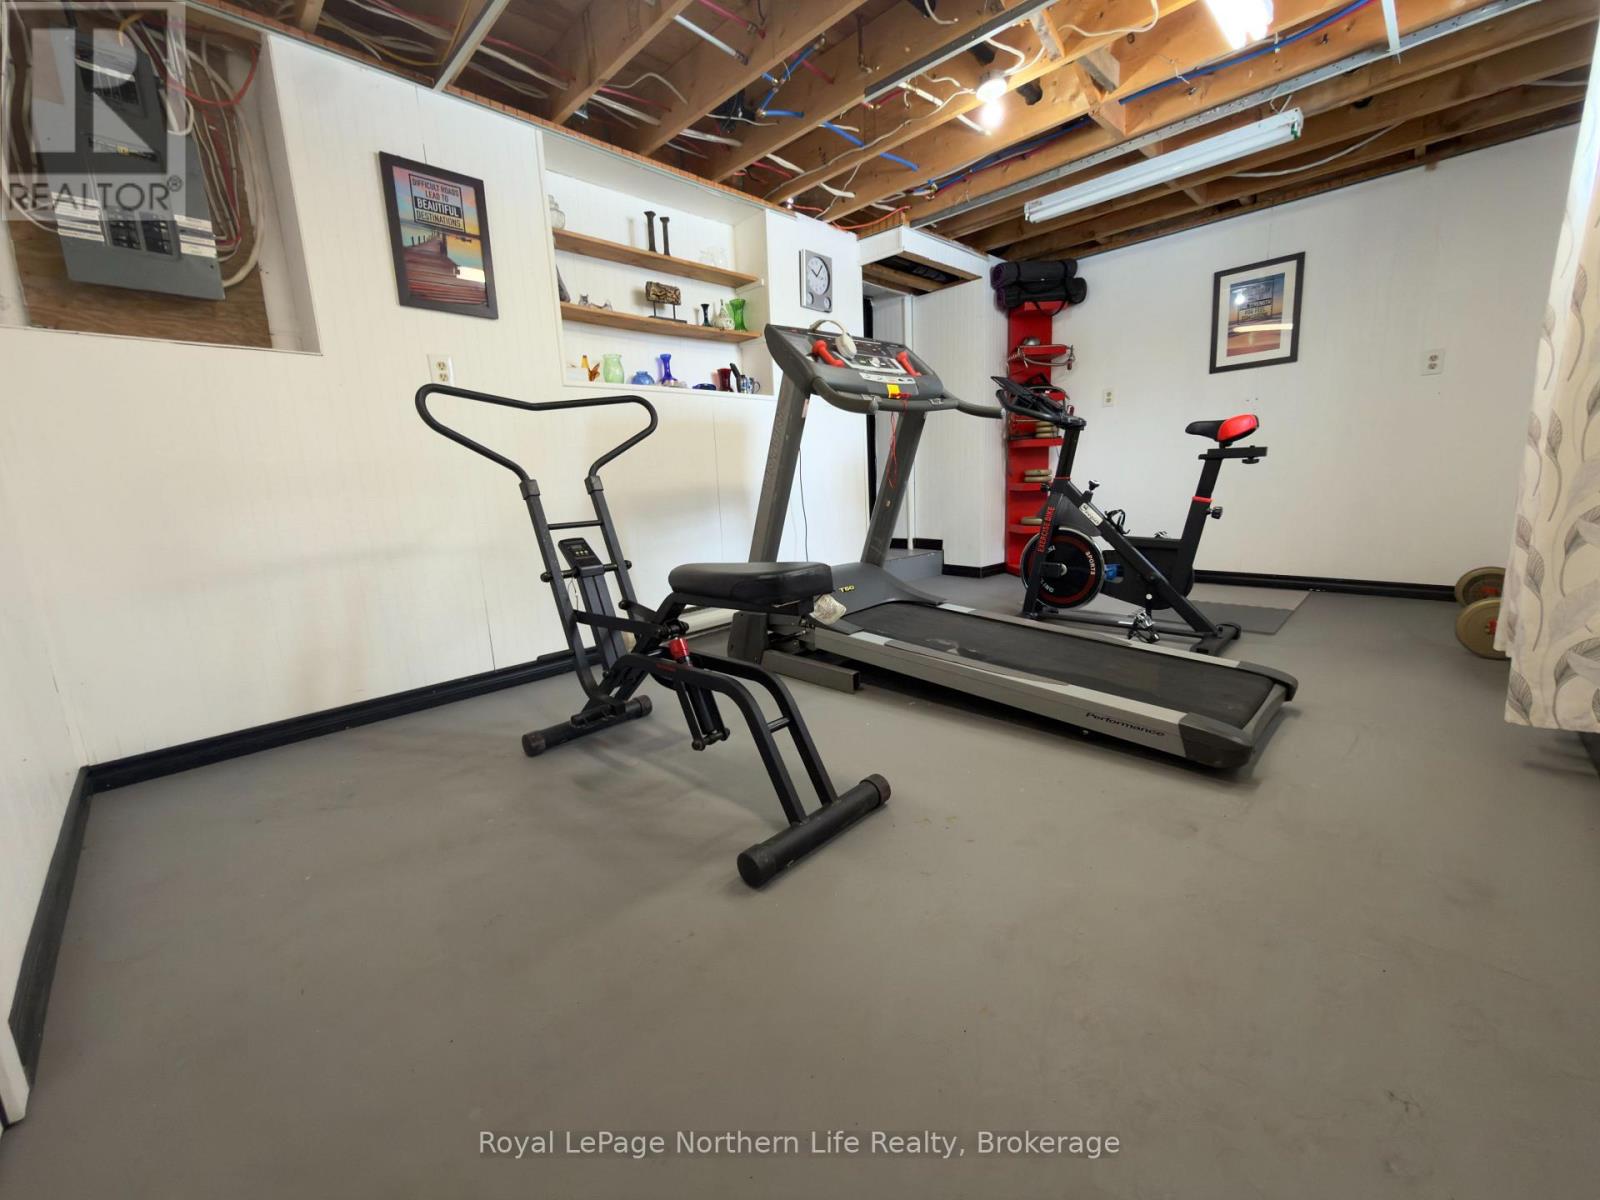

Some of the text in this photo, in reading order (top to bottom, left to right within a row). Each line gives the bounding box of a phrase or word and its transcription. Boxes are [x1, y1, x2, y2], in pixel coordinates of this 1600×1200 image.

[411, 178, 460, 197] DIFFICULT ROADS
[425, 190, 449, 203] LEAD TO
[416, 198, 460, 217] BEAUTIFUL
[415, 210, 461, 227] DESTINATIONS
[1037, 506, 1056, 553] EXERCISE BIKE
[1086, 712, 1166, 737] Performance
